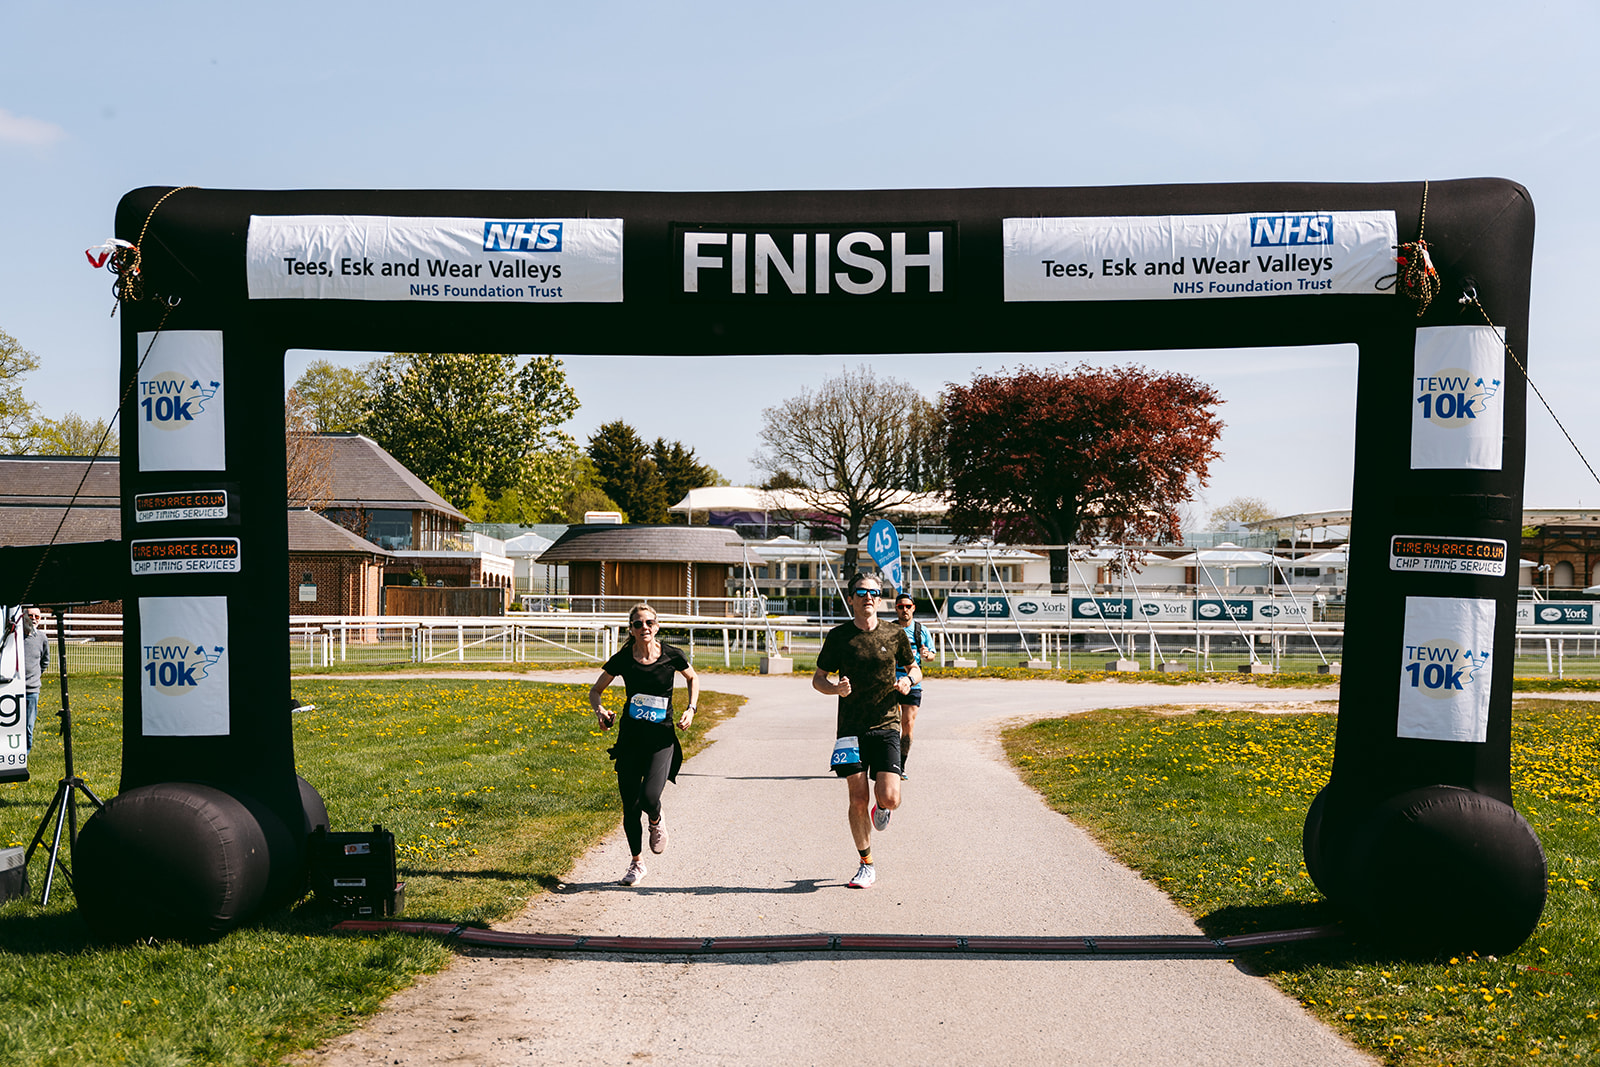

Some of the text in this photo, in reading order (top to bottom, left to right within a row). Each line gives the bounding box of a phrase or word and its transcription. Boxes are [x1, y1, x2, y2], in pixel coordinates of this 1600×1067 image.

[485, 223, 561, 250] NHS
[1253, 216, 1331, 245] NHS
[284, 258, 562, 283] Tees, Esk and Wear Valleys
[684, 231, 944, 295] FINISH
[1042, 253, 1333, 279] Tees, Esk and Wear Valleys
[410, 284, 563, 298] NHS Foundation Trust
[1173, 278, 1333, 294] NHS Foundation Trust
[140, 380, 185, 395] TEWV
[1416, 377, 1470, 391] TEWV
[141, 395, 194, 422] 10k
[1416, 393, 1477, 419] 10k
[139, 508, 225, 521] CHIP TIMING SERVICES
[874, 526, 893, 553] 45
[134, 559, 236, 573] CHIP TIMING SERVICES
[1396, 558, 1503, 573] CHIP TIMING SERVICES
[977, 601, 1003, 611] York
[1041, 601, 1066, 612] York
[1163, 603, 1188, 614] York
[1563, 608, 1588, 618] York
[143, 645, 190, 660] TEWV
[1405, 646, 1460, 663] TEWV
[143, 661, 198, 687] 10k
[1405, 662, 1464, 690] 10k
[635, 708, 657, 722] 248
[833, 752, 848, 764] 32
